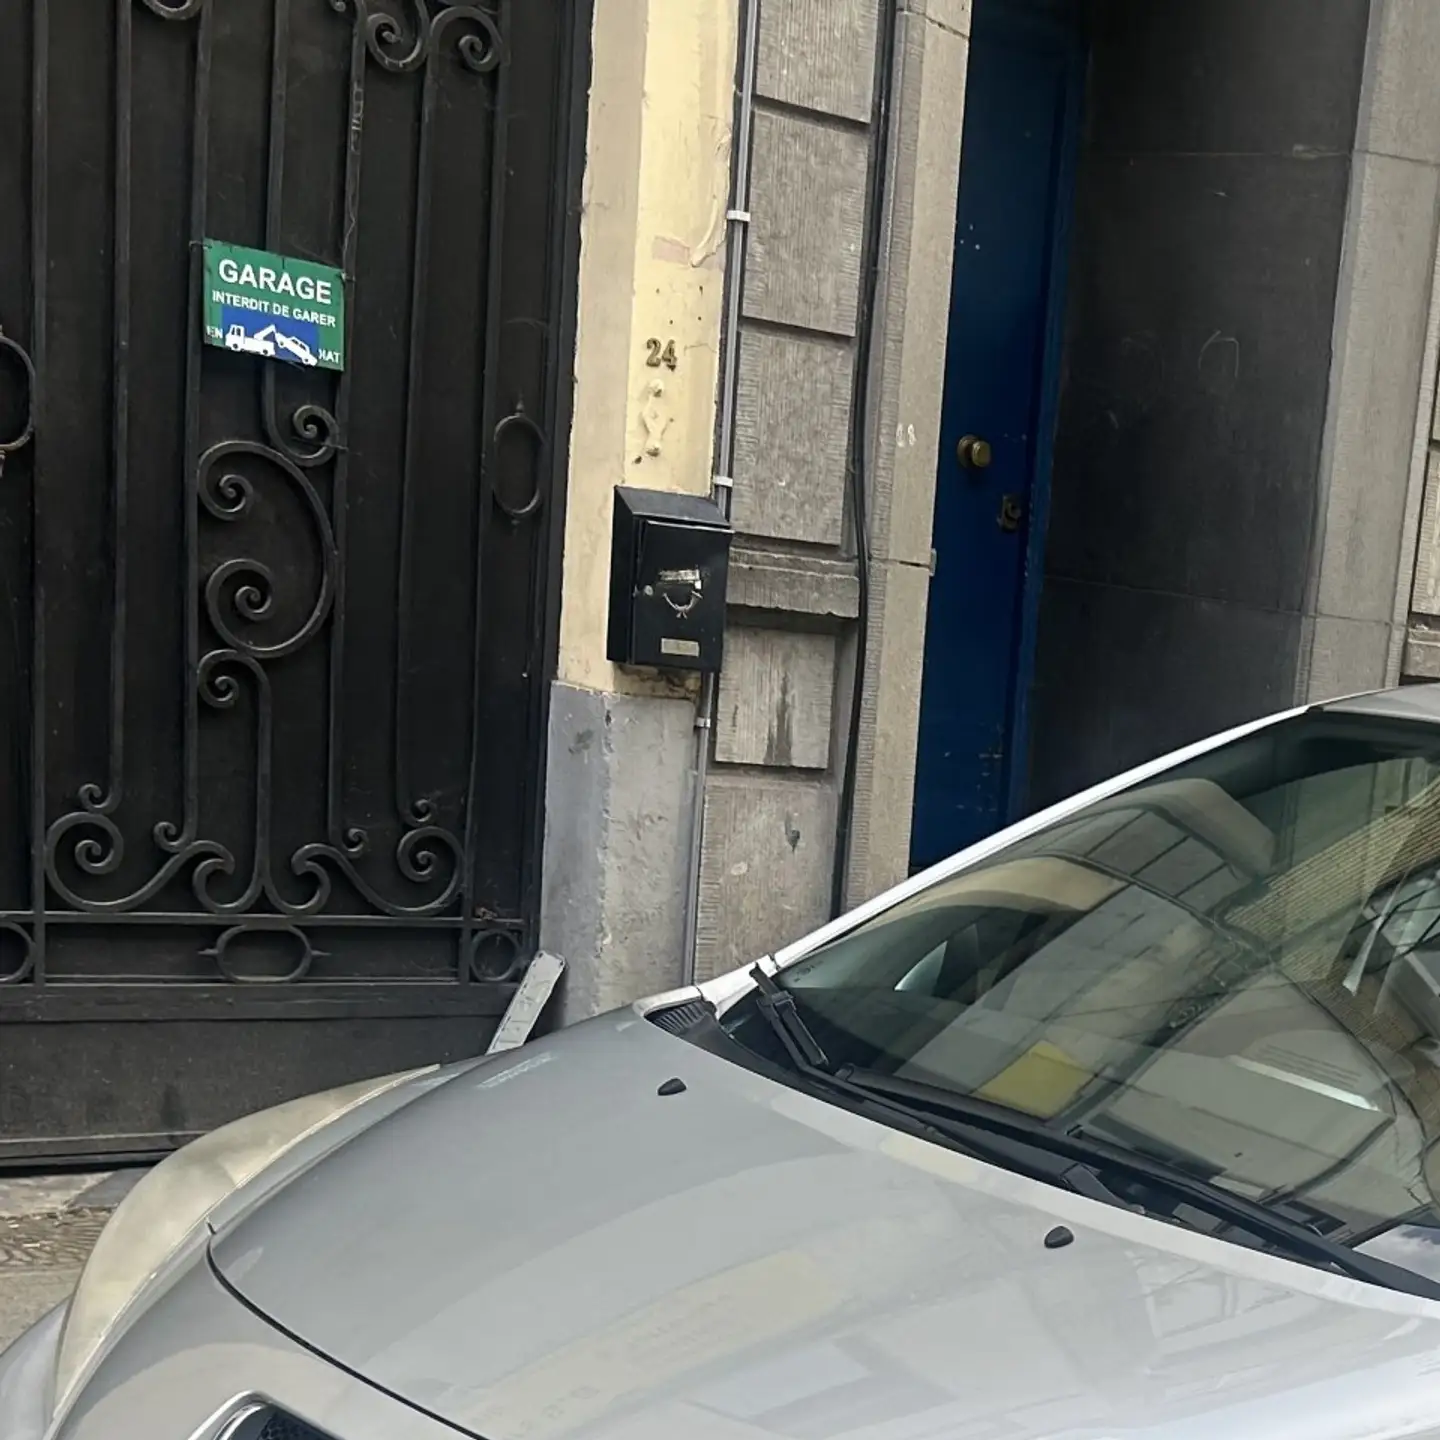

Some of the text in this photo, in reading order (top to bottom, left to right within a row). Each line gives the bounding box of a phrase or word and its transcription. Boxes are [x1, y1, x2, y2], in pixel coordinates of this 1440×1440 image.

[218, 258, 332, 305] GARAGE
[212, 290, 336, 328] INTERDIT DE GARER
[646, 337, 678, 372] 24
